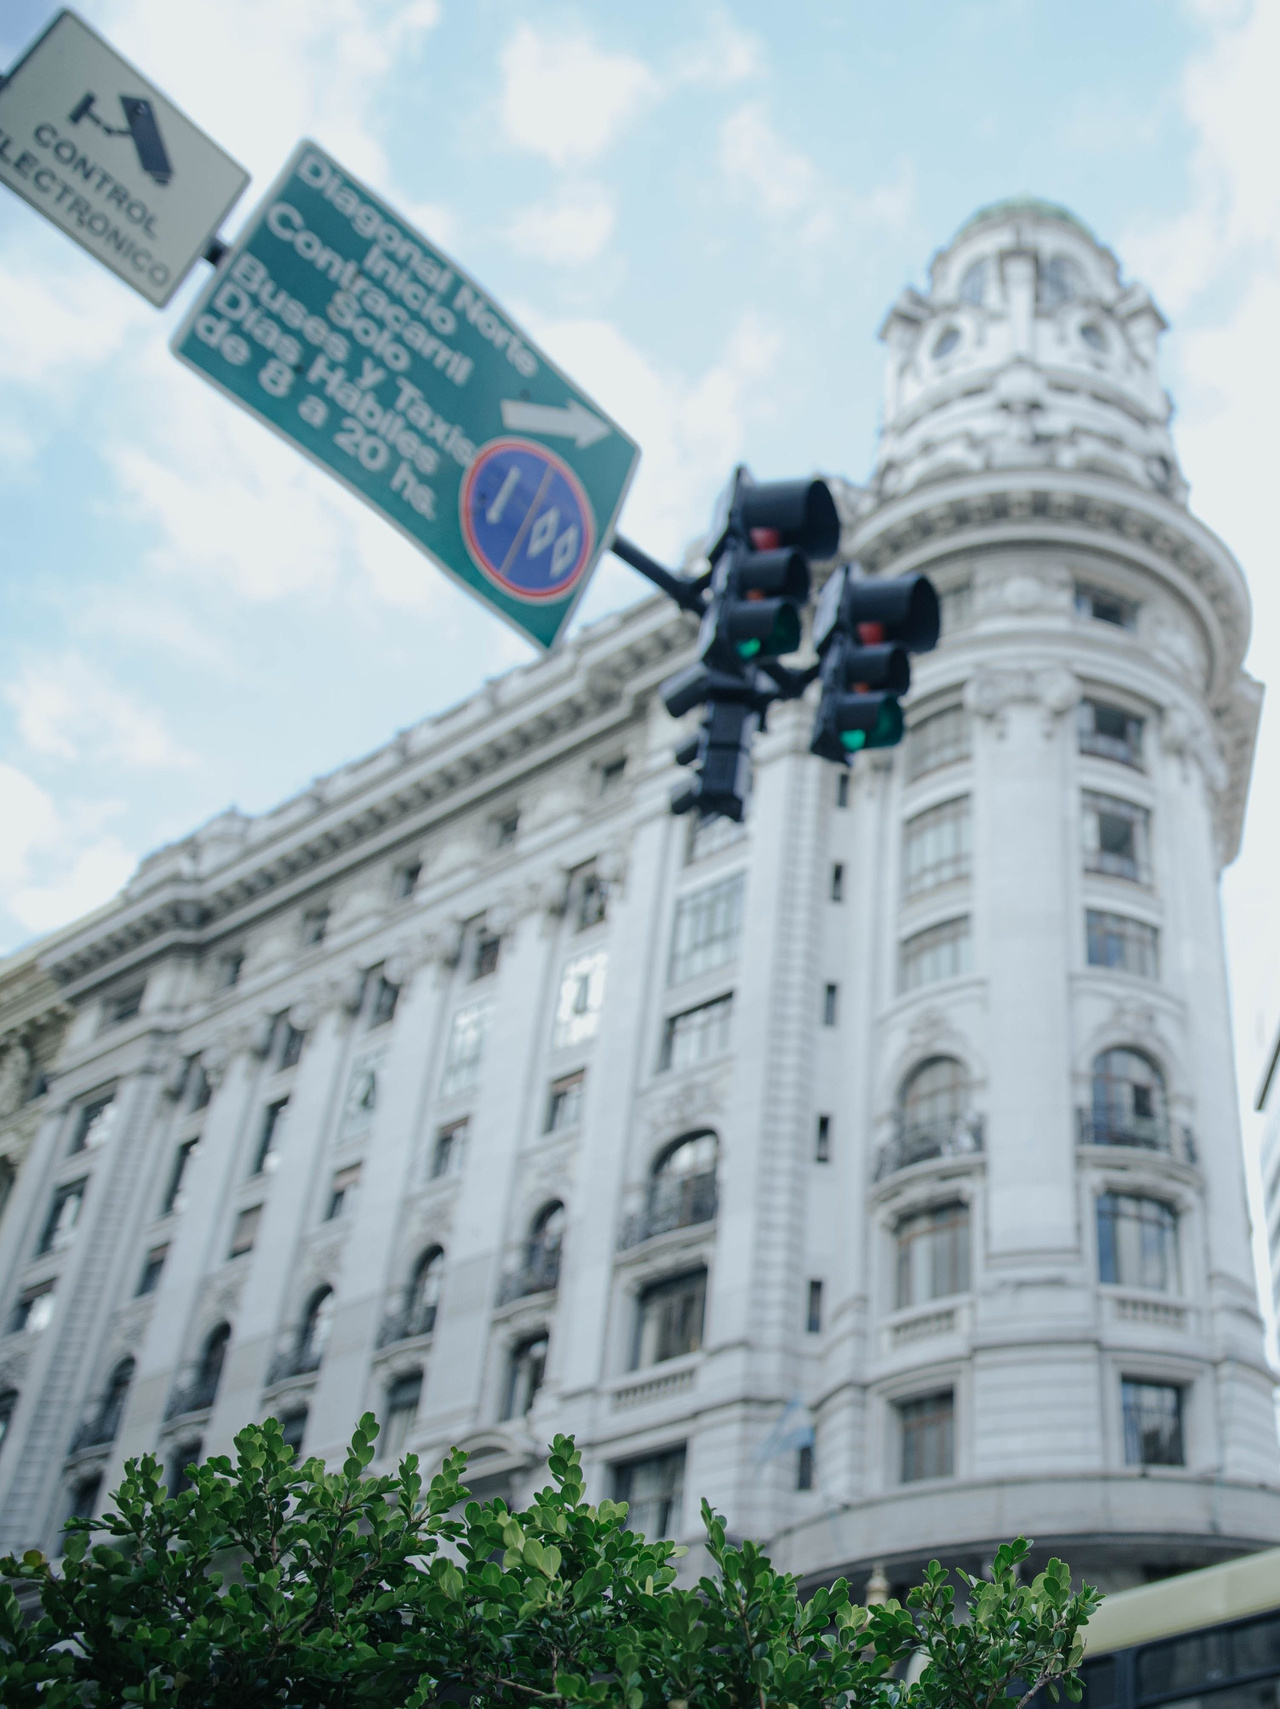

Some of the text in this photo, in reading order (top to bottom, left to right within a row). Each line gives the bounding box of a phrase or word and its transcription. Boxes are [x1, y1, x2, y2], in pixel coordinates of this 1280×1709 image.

[0, 128, 170, 287] LECTRONICO
[34, 123, 156, 239] CONTROL
[264, 202, 474, 387] Contracarril
[298, 153, 538, 378] Diagonal Norte
[326, 290, 411, 373] Solo
[363, 243, 457, 336] Inicio
[195, 312, 251, 366] de
[258, 358, 295, 398] 8
[297, 394, 329, 429] a
[332, 416, 390, 472] 20
[231, 252, 477, 468] Buses y Taxis
